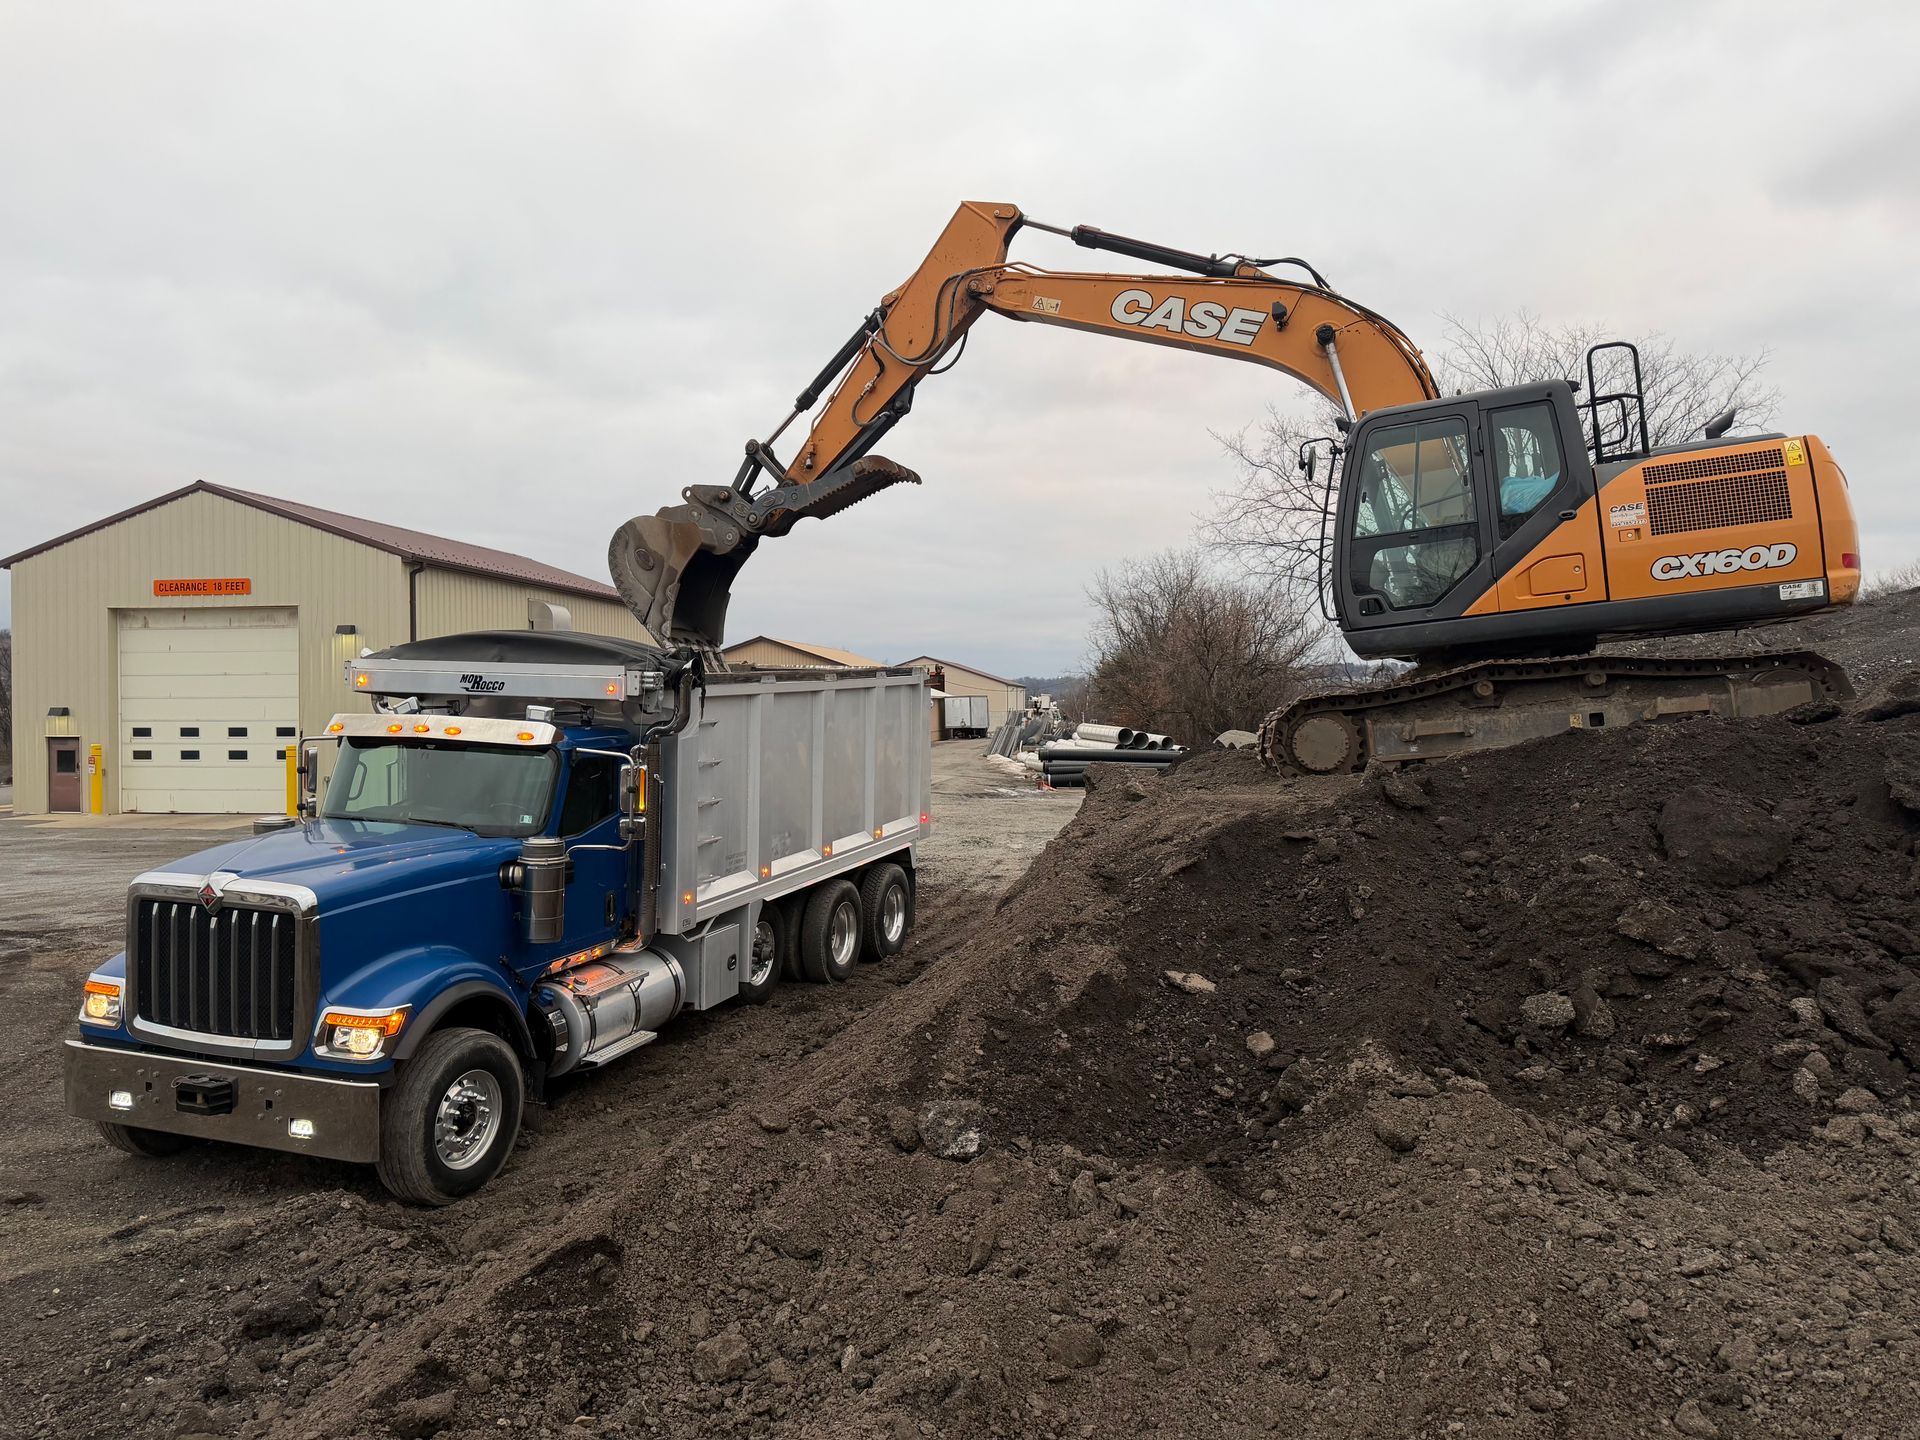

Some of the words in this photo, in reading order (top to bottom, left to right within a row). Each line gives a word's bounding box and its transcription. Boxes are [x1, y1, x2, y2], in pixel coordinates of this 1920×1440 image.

[1110, 289, 1267, 346] CASE
[1610, 502, 1644, 513] CASE
[1650, 542, 1798, 581] CX160D
[158, 582, 208, 592] CLEARANCE
[213, 582, 222, 591] 18
[225, 581, 245, 591] FEET
